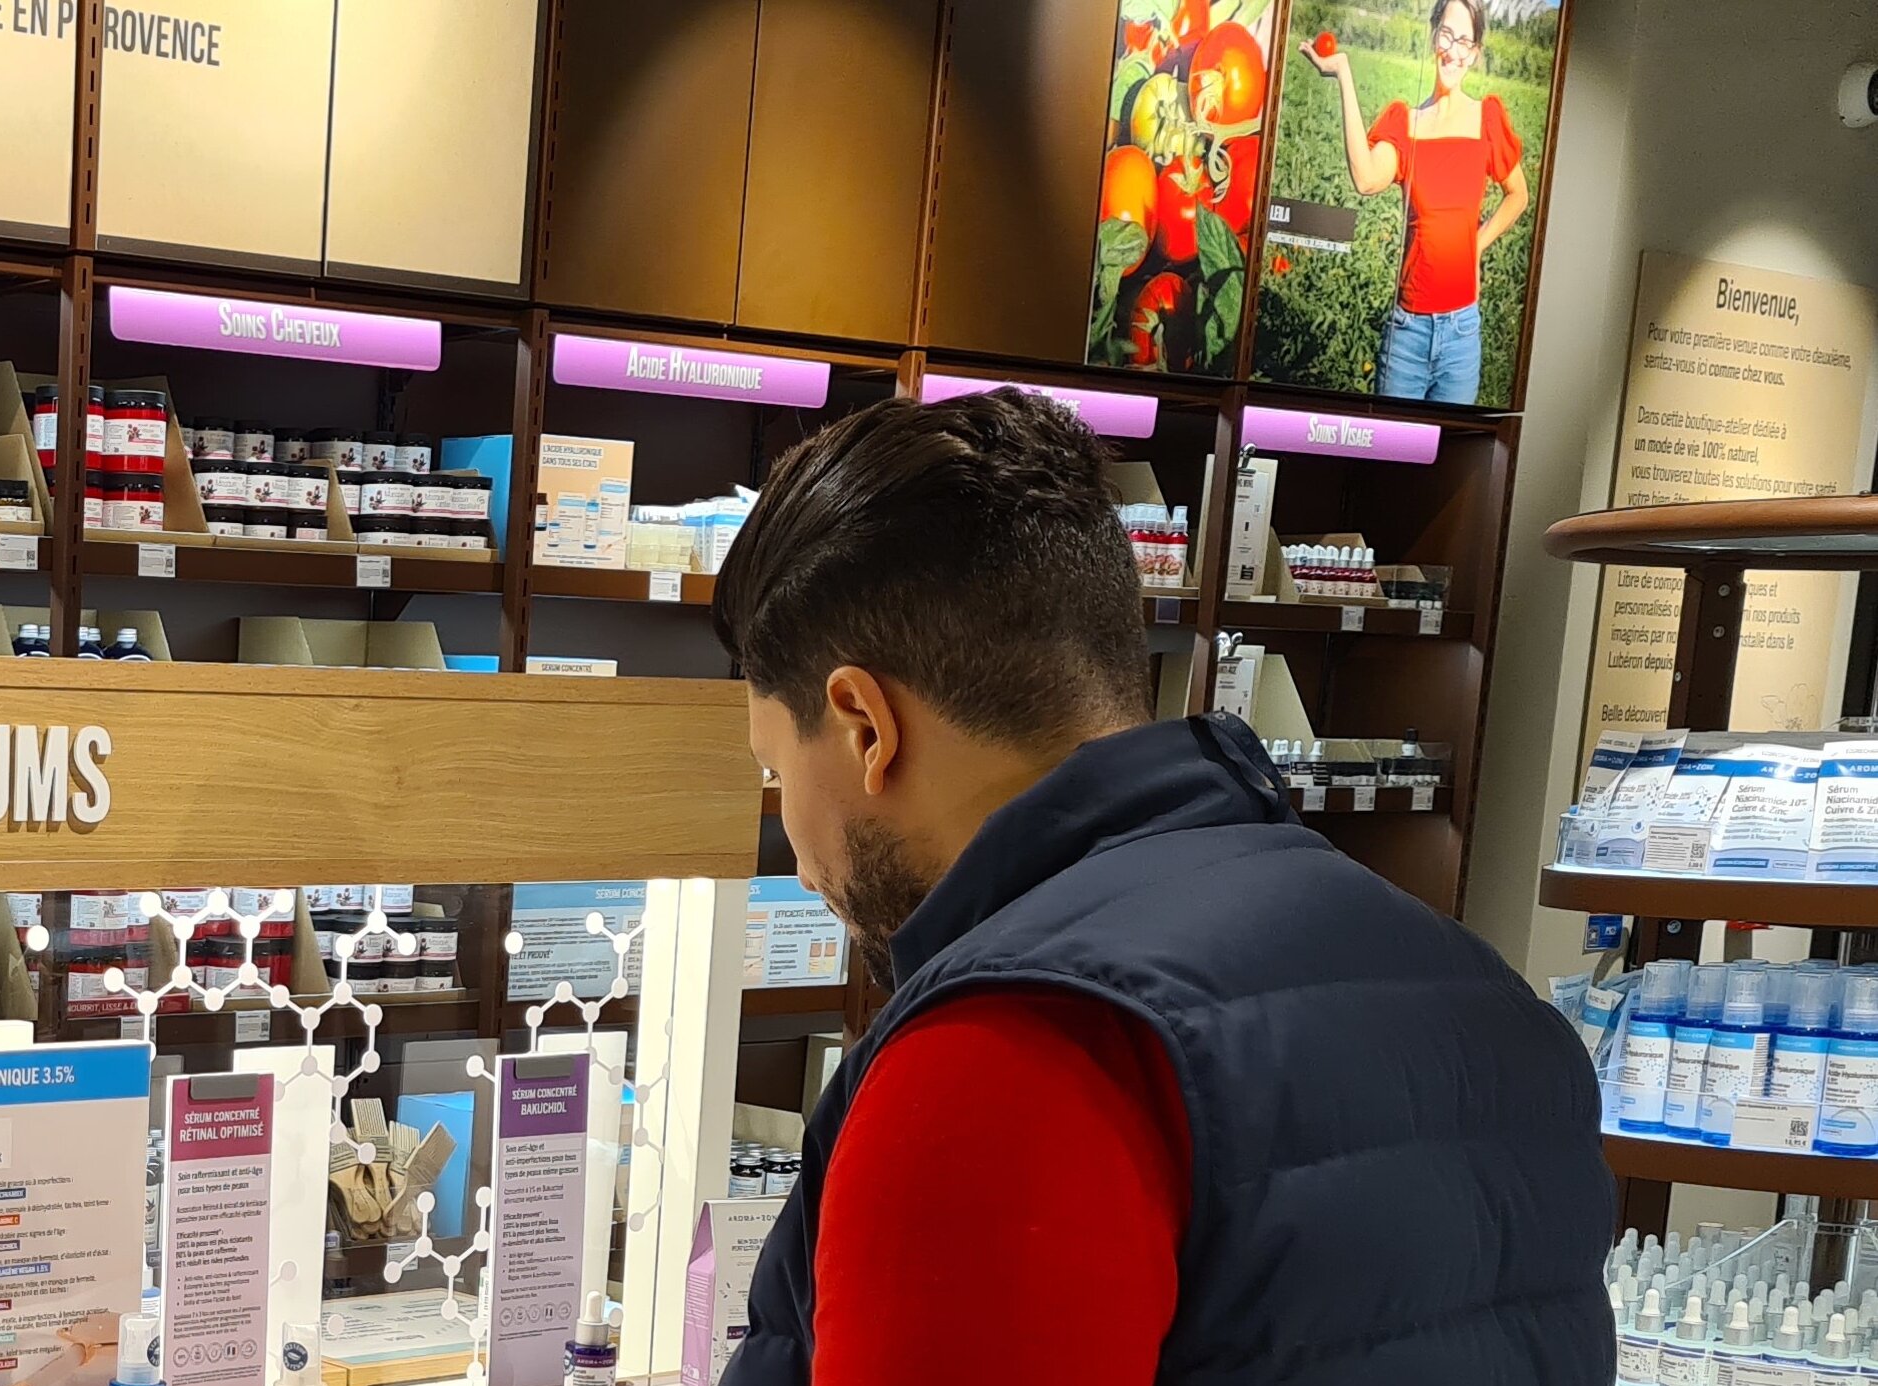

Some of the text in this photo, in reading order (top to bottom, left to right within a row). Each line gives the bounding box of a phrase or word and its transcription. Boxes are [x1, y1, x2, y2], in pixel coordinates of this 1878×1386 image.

[14, 0, 47, 36] EN
[1715, 277, 1801, 326] Bienvenue,
[218, 301, 341, 347] SOINS CHEVEUX
[1648, 321, 1669, 344] Pour
[1670, 328, 1692, 347] votre
[1693, 331, 1731, 355] première
[1733, 336, 1757, 356] venue
[1759, 340, 1789, 360] comme
[1790, 343, 1812, 363] votre
[626, 347, 763, 390] ACIDE HYALURONIQUE
[1644, 352, 1785, 386] sentez-vous ici comme chez vous.
[1307, 416, 1374, 448] SOINS VISAGE
[1637, 405, 1787, 440] Dans cette boutique-atelier dédiée à
[1635, 438, 1759, 467] un mode de vie 100% naturel,
[1631, 463, 1651, 481] vous
[1653, 464, 1693, 485] trouverez
[1694, 467, 1721, 488] toutes
[1722, 469, 1734, 488] les
[1735, 470, 1772, 492] solutions
[1773, 477, 1792, 495] pour
[1617, 569, 1652, 590] Libre de
[1769, 582, 1778, 598] et
[1614, 599, 1672, 620] personnalisés
[1752, 606, 1801, 626] nos produits
[1610, 624, 1665, 646] imaginés par
[1767, 634, 1794, 650] dans le
[1608, 650, 1673, 674] Lubéron depuis
[1601, 704, 1623, 722] Belle
[1827, 784, 1859, 794] Sérum
[1825, 805, 1864, 815] Cuivre &
[184, 1107, 260, 1125] SÉRUM CONCENTRÉ
[521, 1101, 567, 1115] BAKUCHIOL
[180, 1122, 264, 1142] RÉTINAL OPTIMISÉ
